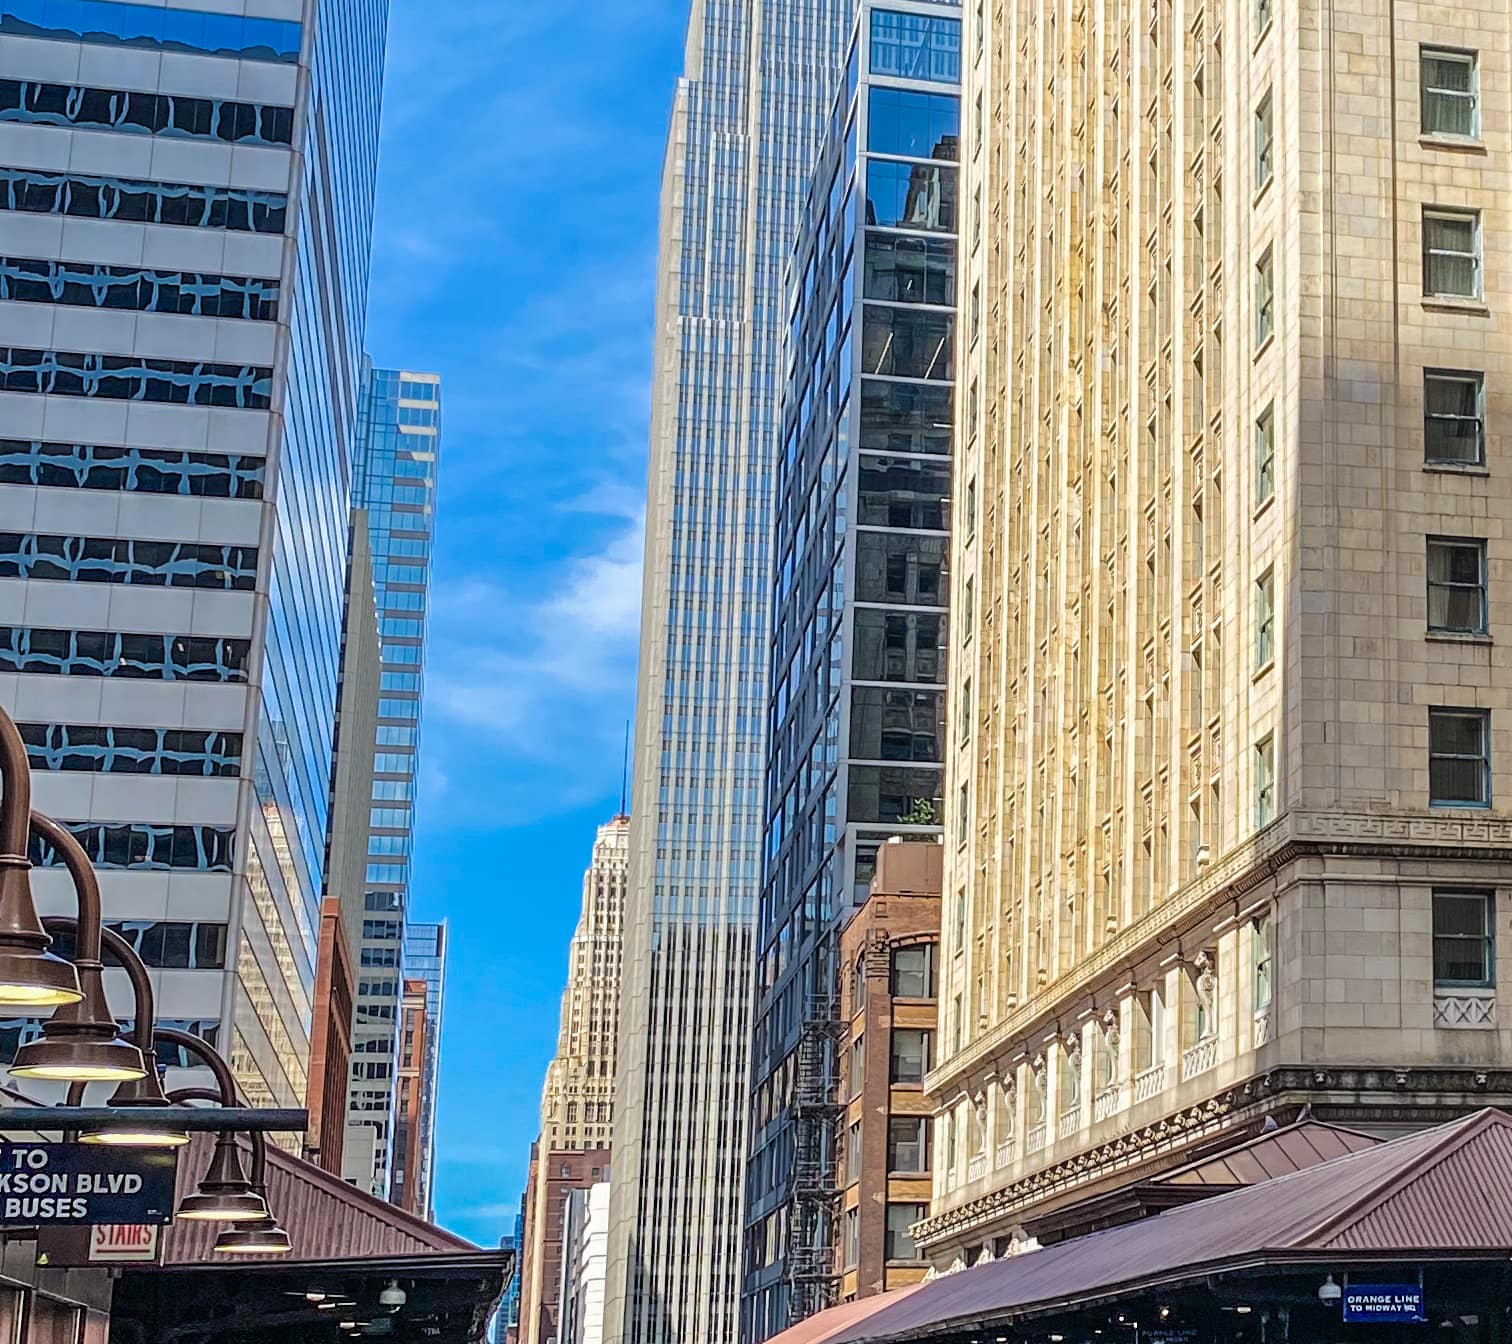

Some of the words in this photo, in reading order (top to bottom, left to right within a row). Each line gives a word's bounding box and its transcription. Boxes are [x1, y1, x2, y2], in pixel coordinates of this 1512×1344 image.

[12, 1149, 48, 1169] TO
[76, 1174, 142, 1194] BLVD
[4, 1198, 88, 1218] BUSES
[96, 1225, 152, 1245] STAIRS
[1347, 1295, 1391, 1304] ORANGE
[1394, 1295, 1420, 1303] LINE
[1350, 1304, 1363, 1312] TO
[1365, 1304, 1402, 1312] MIDWAY
